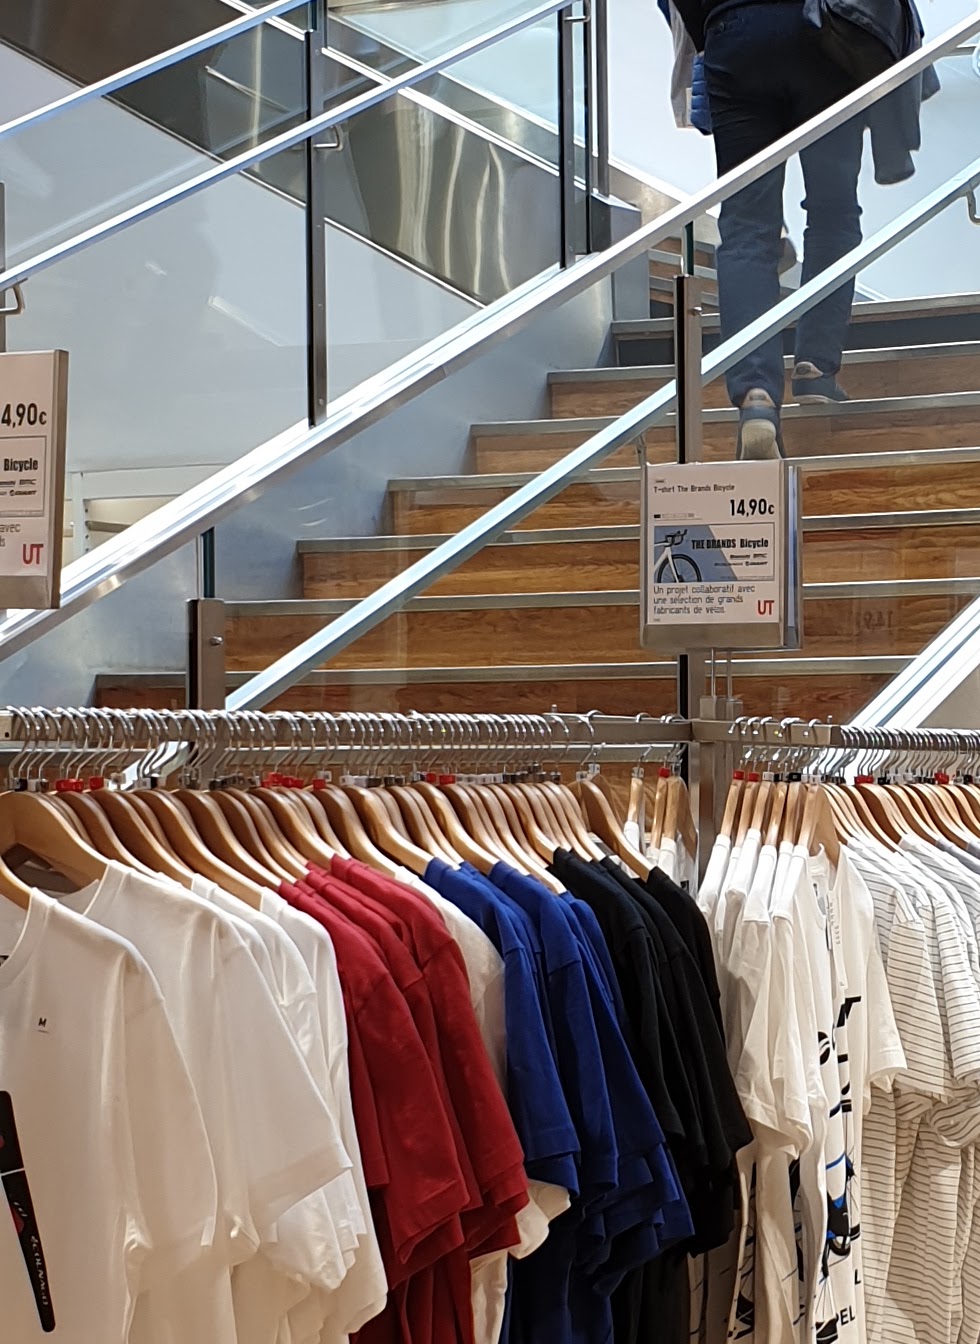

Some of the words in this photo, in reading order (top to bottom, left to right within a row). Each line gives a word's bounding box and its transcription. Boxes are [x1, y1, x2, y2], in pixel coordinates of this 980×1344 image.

[3, 458, 39, 472] Bicycle
[677, 485, 688, 493] The
[690, 484, 711, 493] Brands
[713, 483, 735, 493] Bicycle
[691, 539, 706, 549] THE
[706, 538, 736, 549] BRANDS
[739, 537, 769, 549] Bicycle
[22, 543, 44, 565] UT
[653, 585, 664, 594] Un
[666, 584, 688, 597] projet
[691, 583, 734, 595] collaboratif
[737, 585, 756, 593] avec
[653, 597, 668, 605] une
[705, 595, 714, 604] de
[717, 594, 743, 606] grands
[653, 605, 690, 615] fabricants
[693, 605, 702, 614] de
[757, 599, 775, 616] UT
[38, 1017, 47, 1027] M
